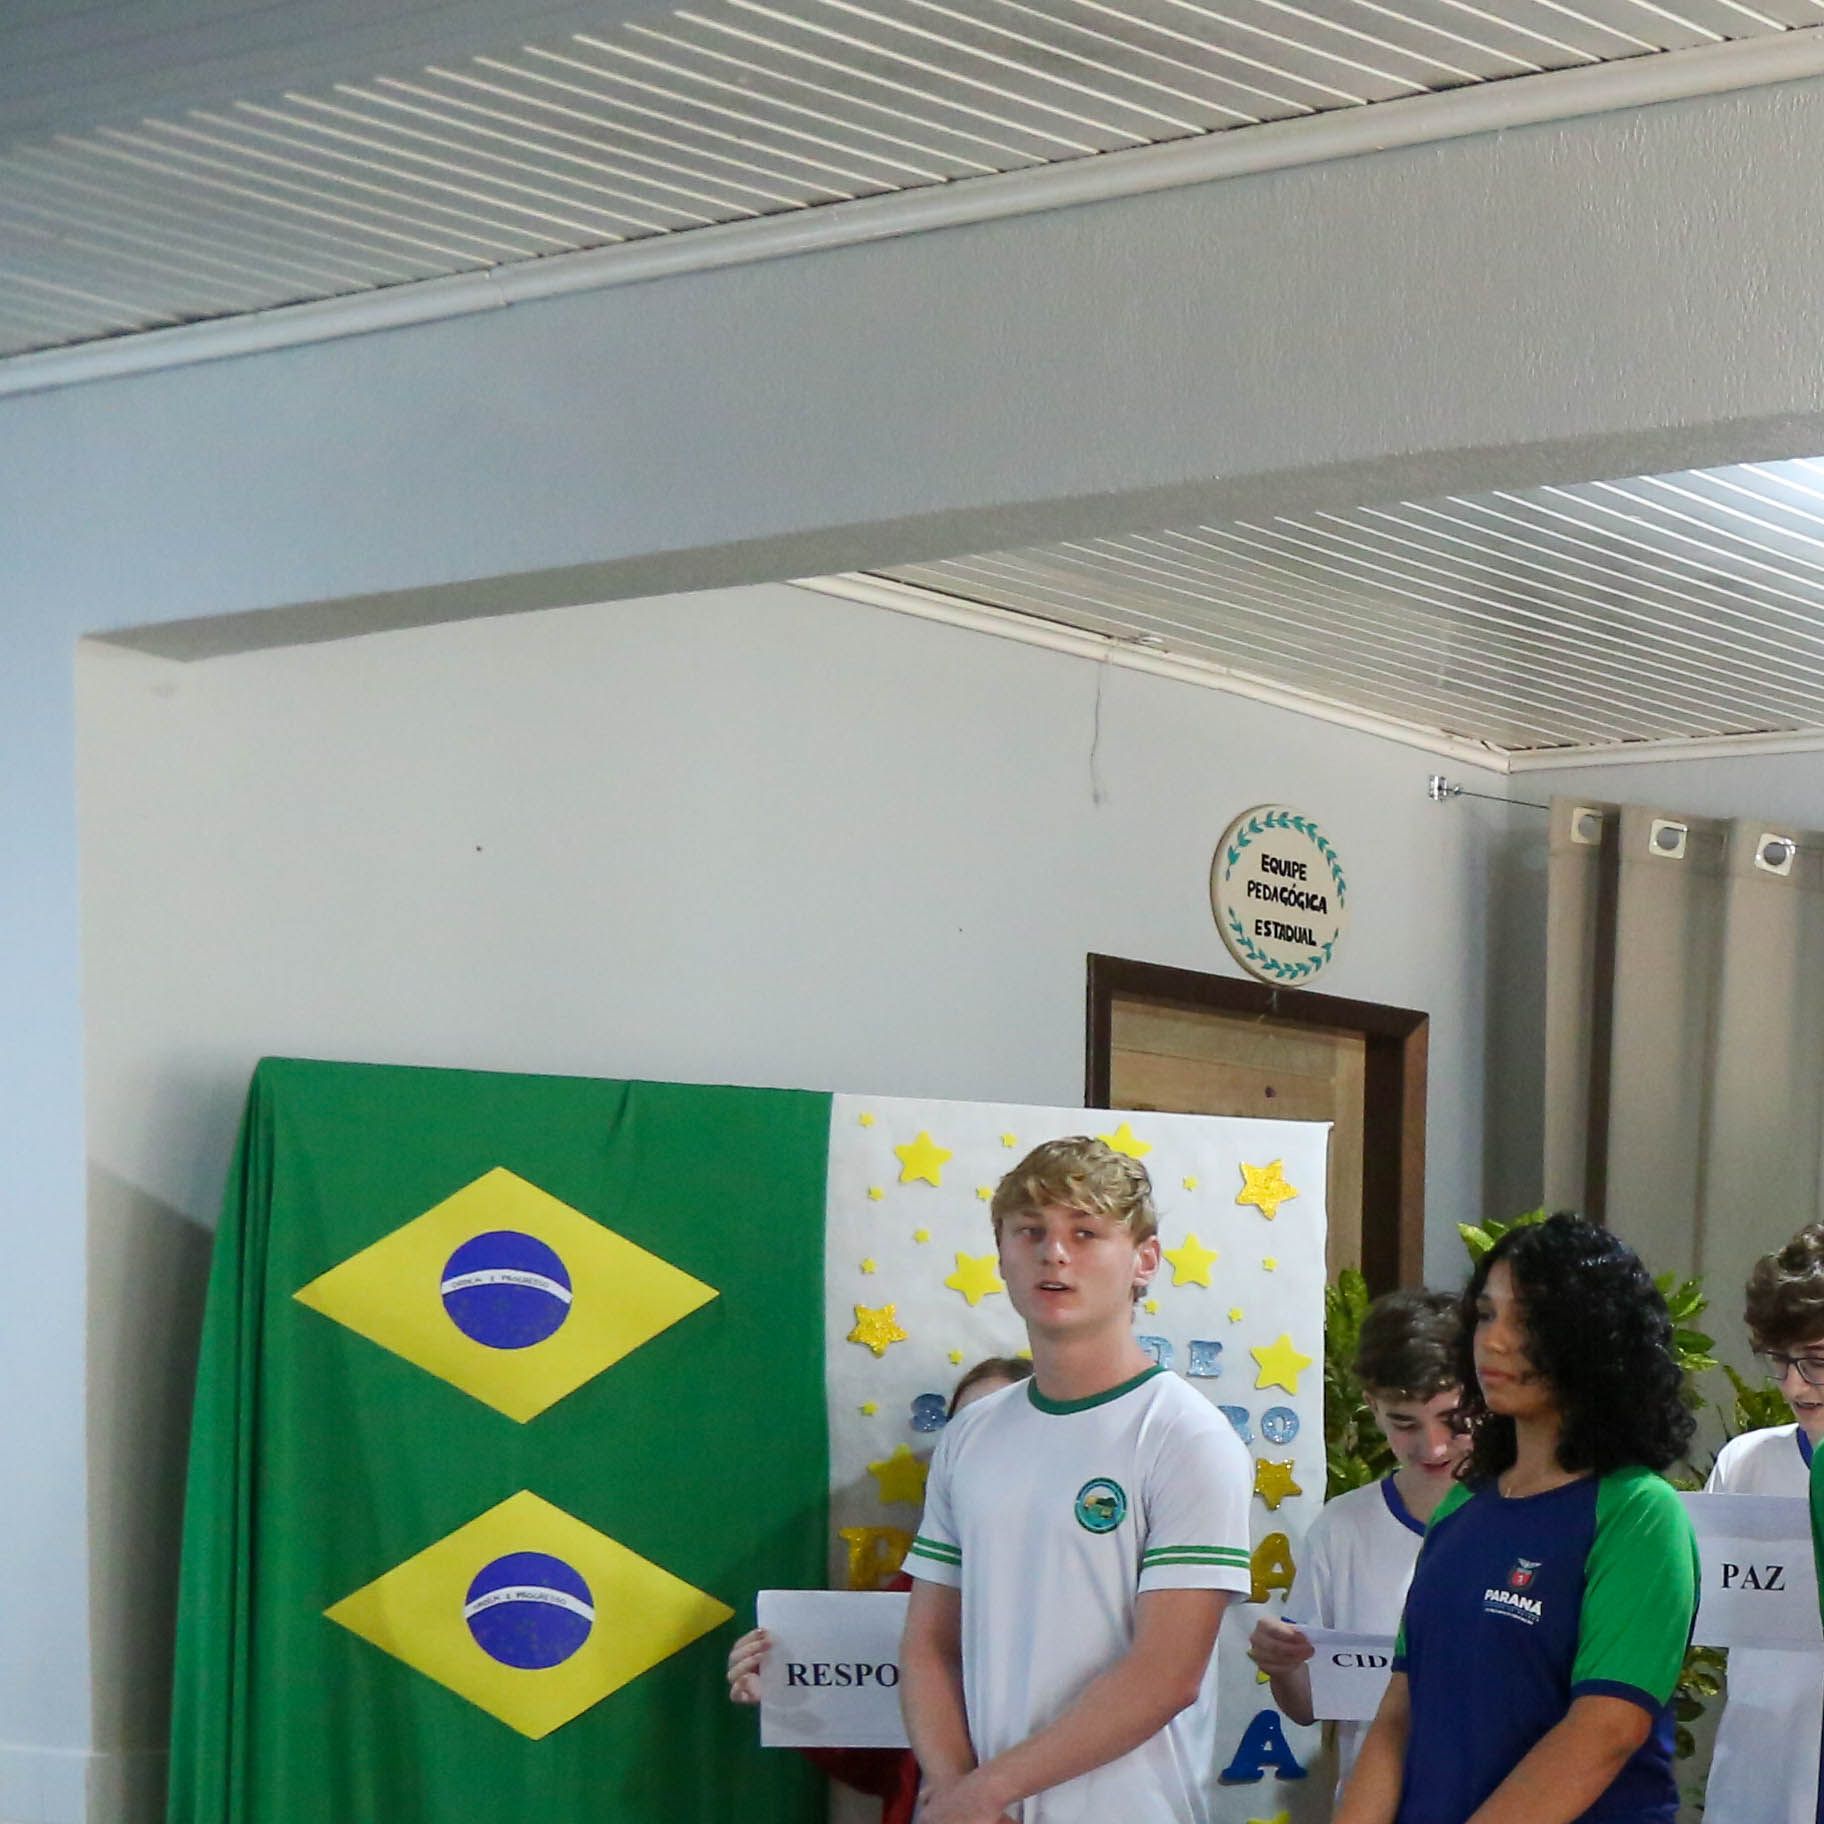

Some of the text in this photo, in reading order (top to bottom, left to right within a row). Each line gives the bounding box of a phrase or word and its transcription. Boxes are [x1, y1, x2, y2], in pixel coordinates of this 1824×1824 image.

[1260, 853, 1307, 881] EQUIPE
[1247, 880, 1328, 914] PEDAGÓGICA
[1254, 919, 1317, 947] ESTADUAL
[1721, 1562, 1786, 1592] PAZ
[1484, 1588, 1543, 1616] PARANÁ
